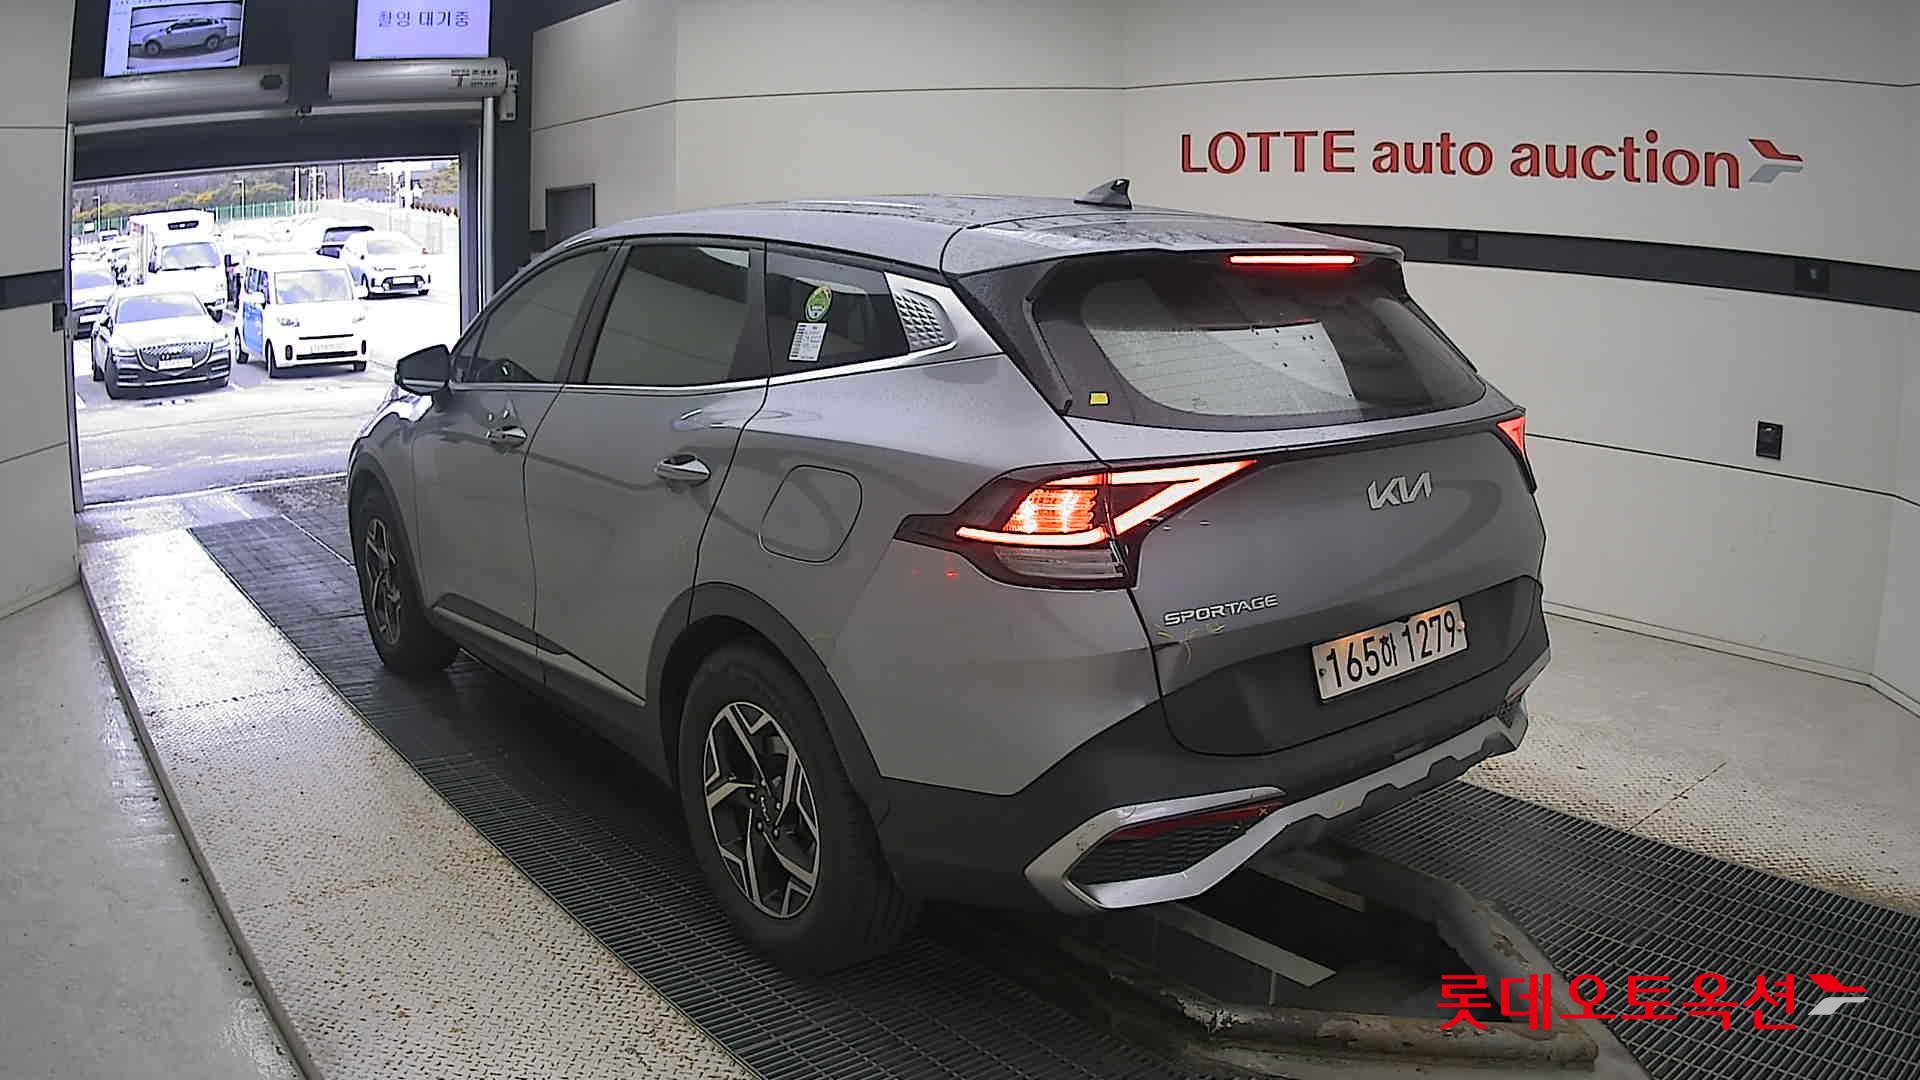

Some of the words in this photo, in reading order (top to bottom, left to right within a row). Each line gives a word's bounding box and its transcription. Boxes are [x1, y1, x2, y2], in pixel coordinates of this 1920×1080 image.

[419, 10, 469, 27] 대기중
[1180, 130, 1356, 174] LOTTE
[1371, 132, 1494, 175] auto
[1510, 130, 1741, 189] auction
[1367, 471, 1432, 509] KIA
[1163, 594, 1279, 626] SPORTAGE
[1326, 632, 1398, 688] 165하
[1401, 610, 1456, 662] 1279
